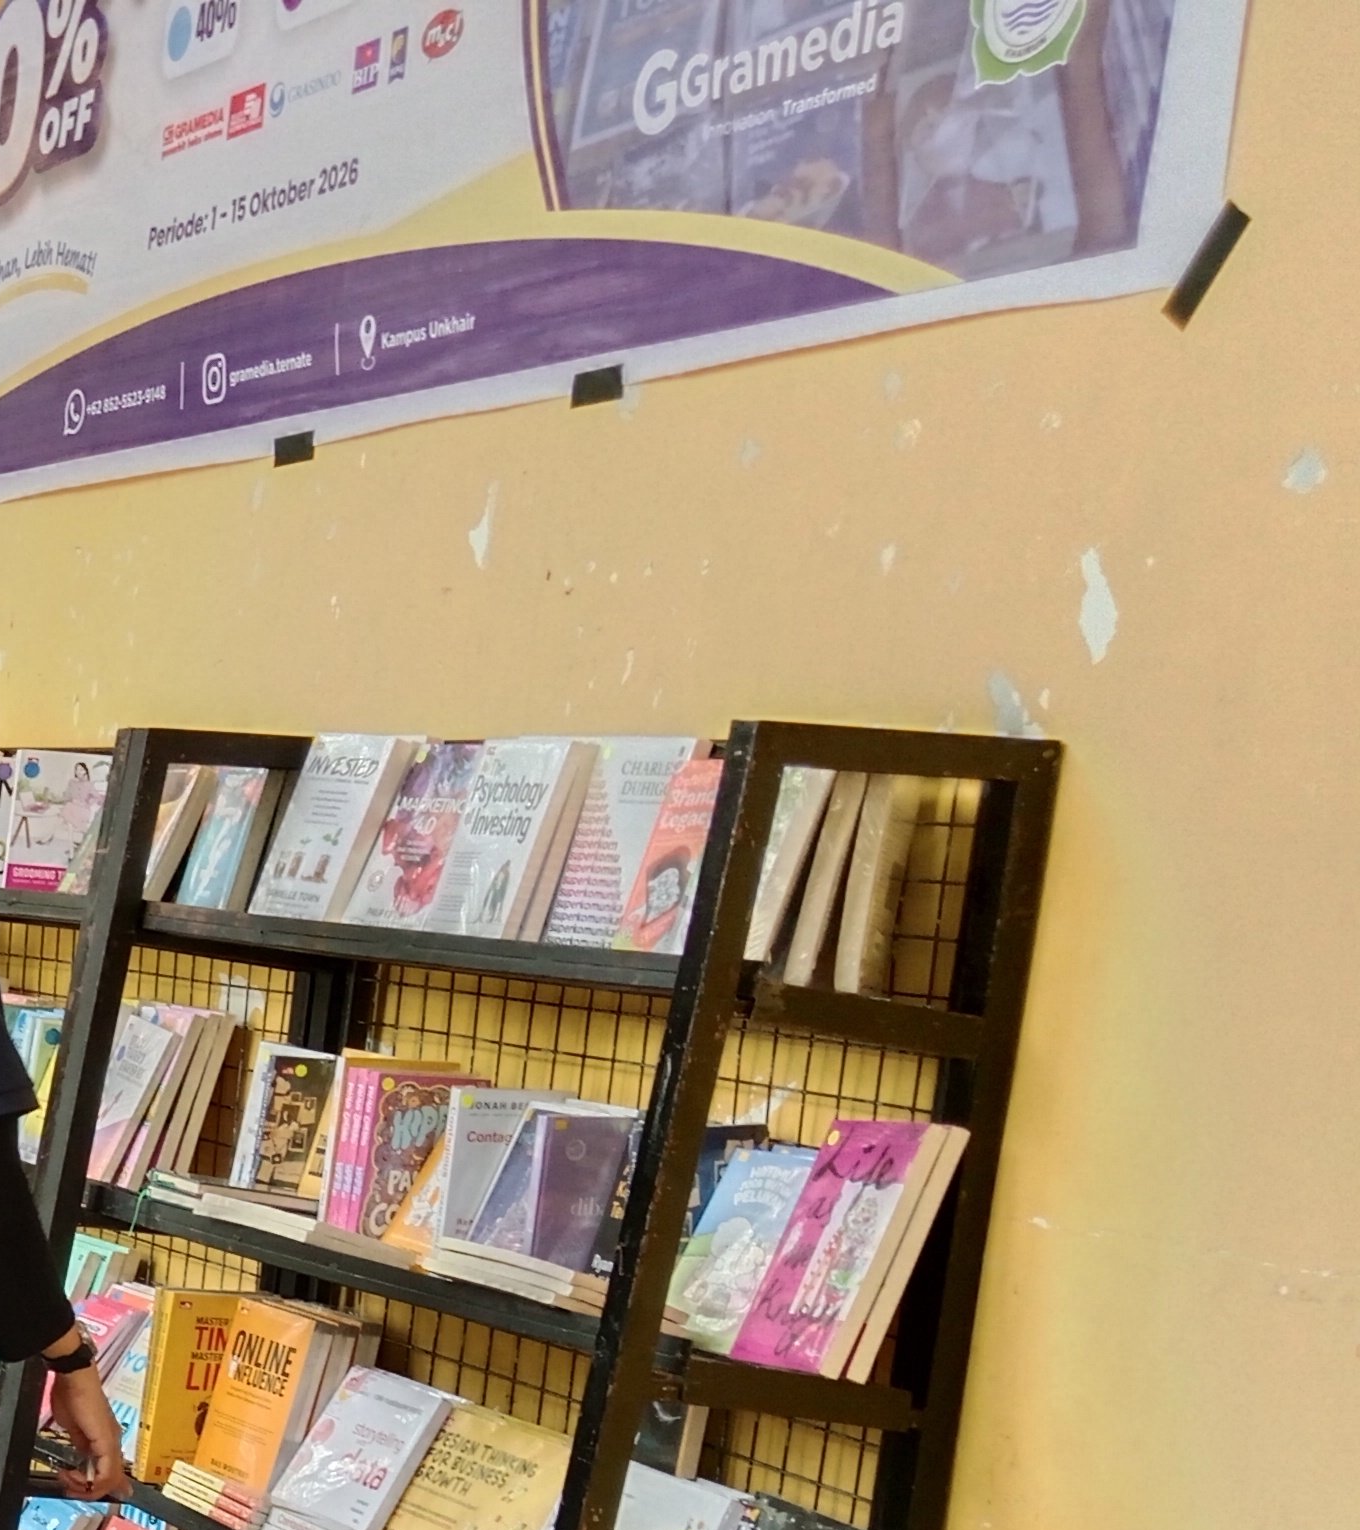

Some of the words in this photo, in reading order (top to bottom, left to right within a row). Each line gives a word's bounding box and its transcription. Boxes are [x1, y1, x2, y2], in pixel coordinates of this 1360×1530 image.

[681, 0, 906, 108] Gramedia
[782, 74, 878, 118] Transformed
[39, 89, 96, 155] OFF
[148, 215, 207, 250] Periode:
[211, 205, 217, 230] 1
[231, 197, 246, 223] 15
[249, 178, 315, 218] Oktober
[318, 158, 359, 196] 2026
[24, 240, 53, 270] Lebih
[55, 241, 98, 278] Hemat!
[381, 326, 427, 350] Kampus
[429, 313, 476, 340] Unkhair
[229, 352, 313, 387] gramedia.ternate
[306, 755, 379, 779] INVESTED
[470, 774, 549, 811] Psychology
[470, 806, 532, 844] Investing
[231, 1330, 297, 1378] ONLINE
[451, 1457, 510, 1489] BUSINESS
[483, 1444, 538, 1478] THINKING
[416, 1464, 472, 1497] GROWTH
